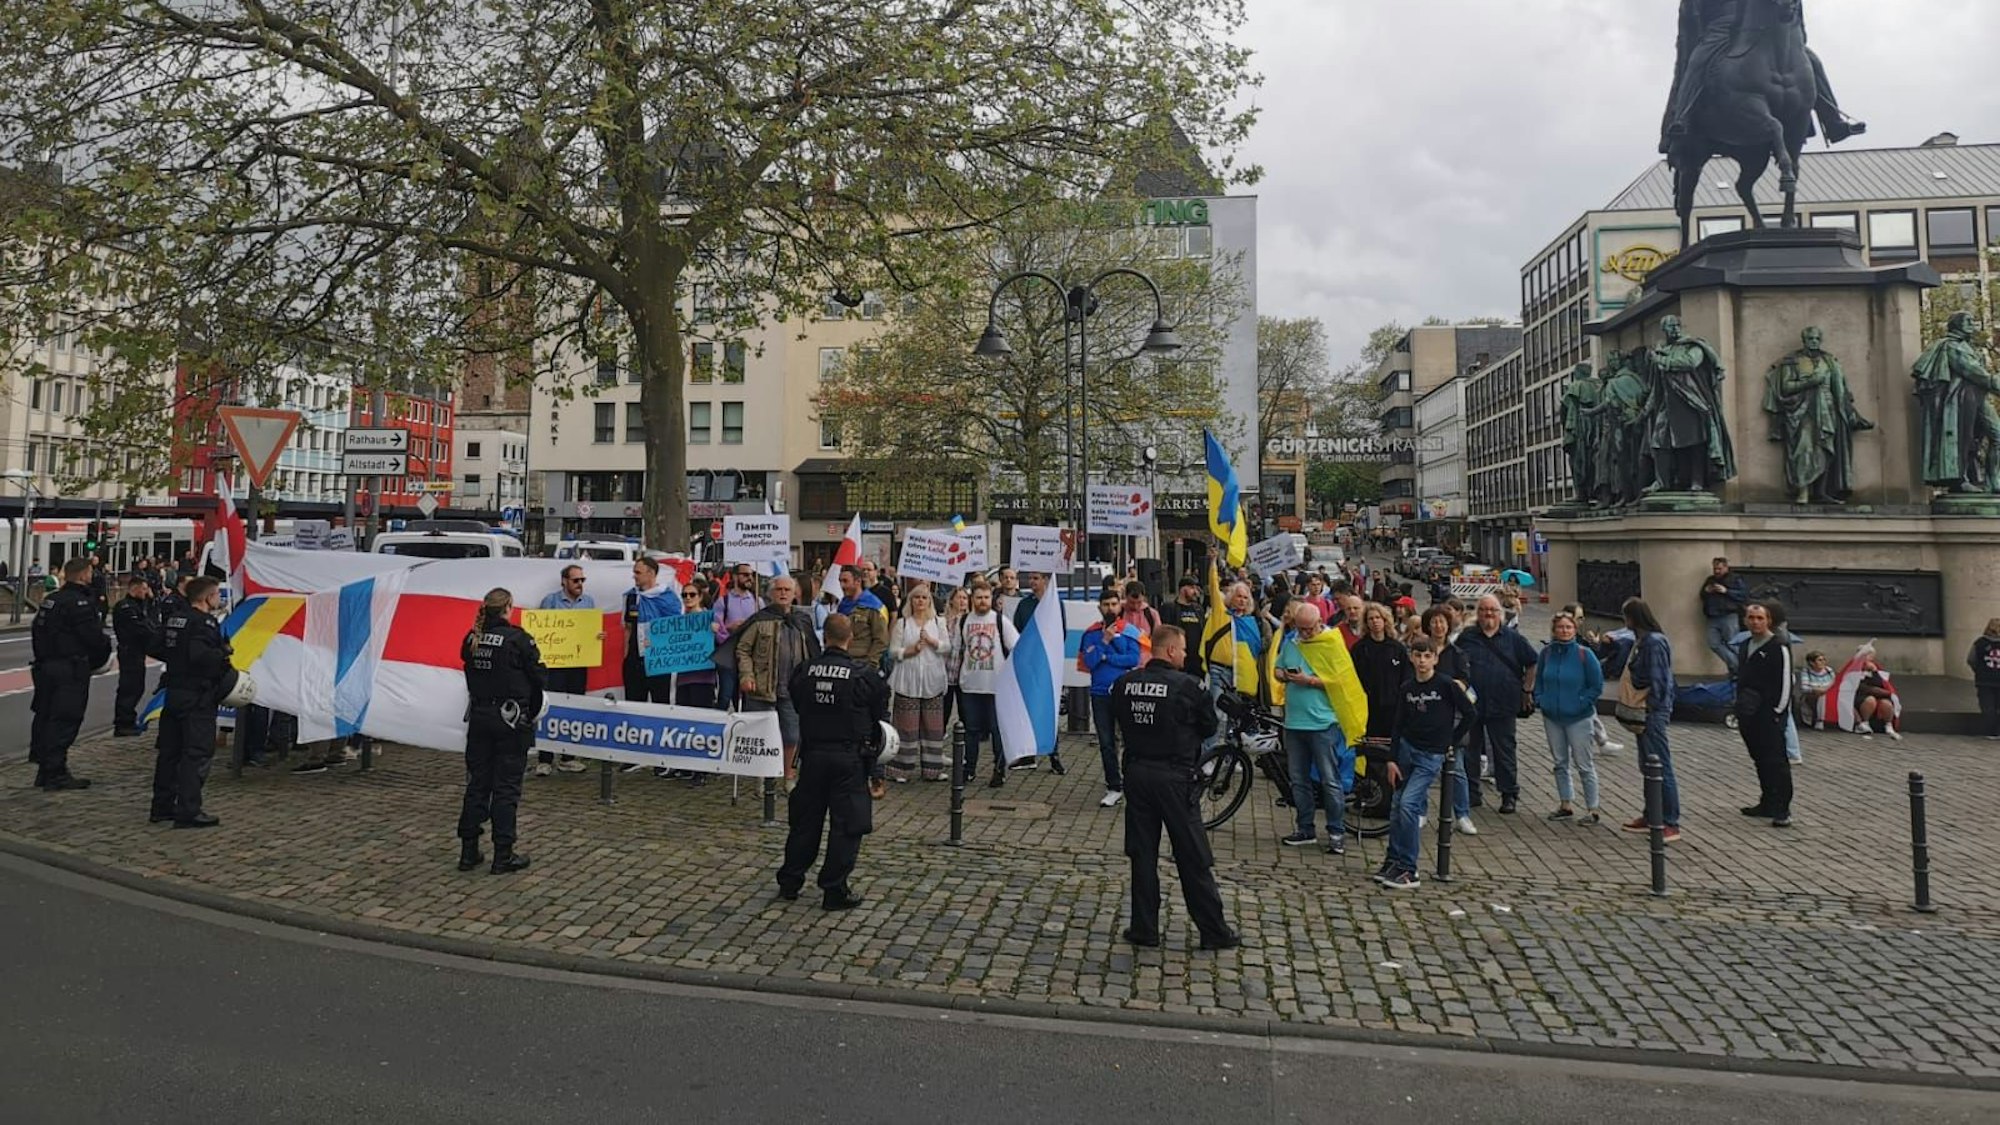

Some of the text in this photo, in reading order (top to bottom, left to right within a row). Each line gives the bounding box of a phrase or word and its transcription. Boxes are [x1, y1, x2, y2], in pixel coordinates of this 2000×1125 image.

[1141, 199, 1208, 224] TING
[349, 434, 388, 444] Rathaus
[349, 459, 386, 470] Altstadt
[735, 522, 779, 531] Память
[909, 535, 926, 543] Kein
[526, 612, 576, 629] Putins
[537, 631, 567, 650] elfer
[808, 664, 851, 679] POLIZEI
[1125, 682, 1168, 697] POLIZEI
[1131, 700, 1156, 713] NRW
[547, 717, 608, 742] gegen
[614, 721, 653, 746] den
[659, 726, 722, 757] Krieg
[735, 736, 765, 746] FREIES
[734, 746, 780, 756] RUSSLAND
[732, 754, 752, 764] NRW
